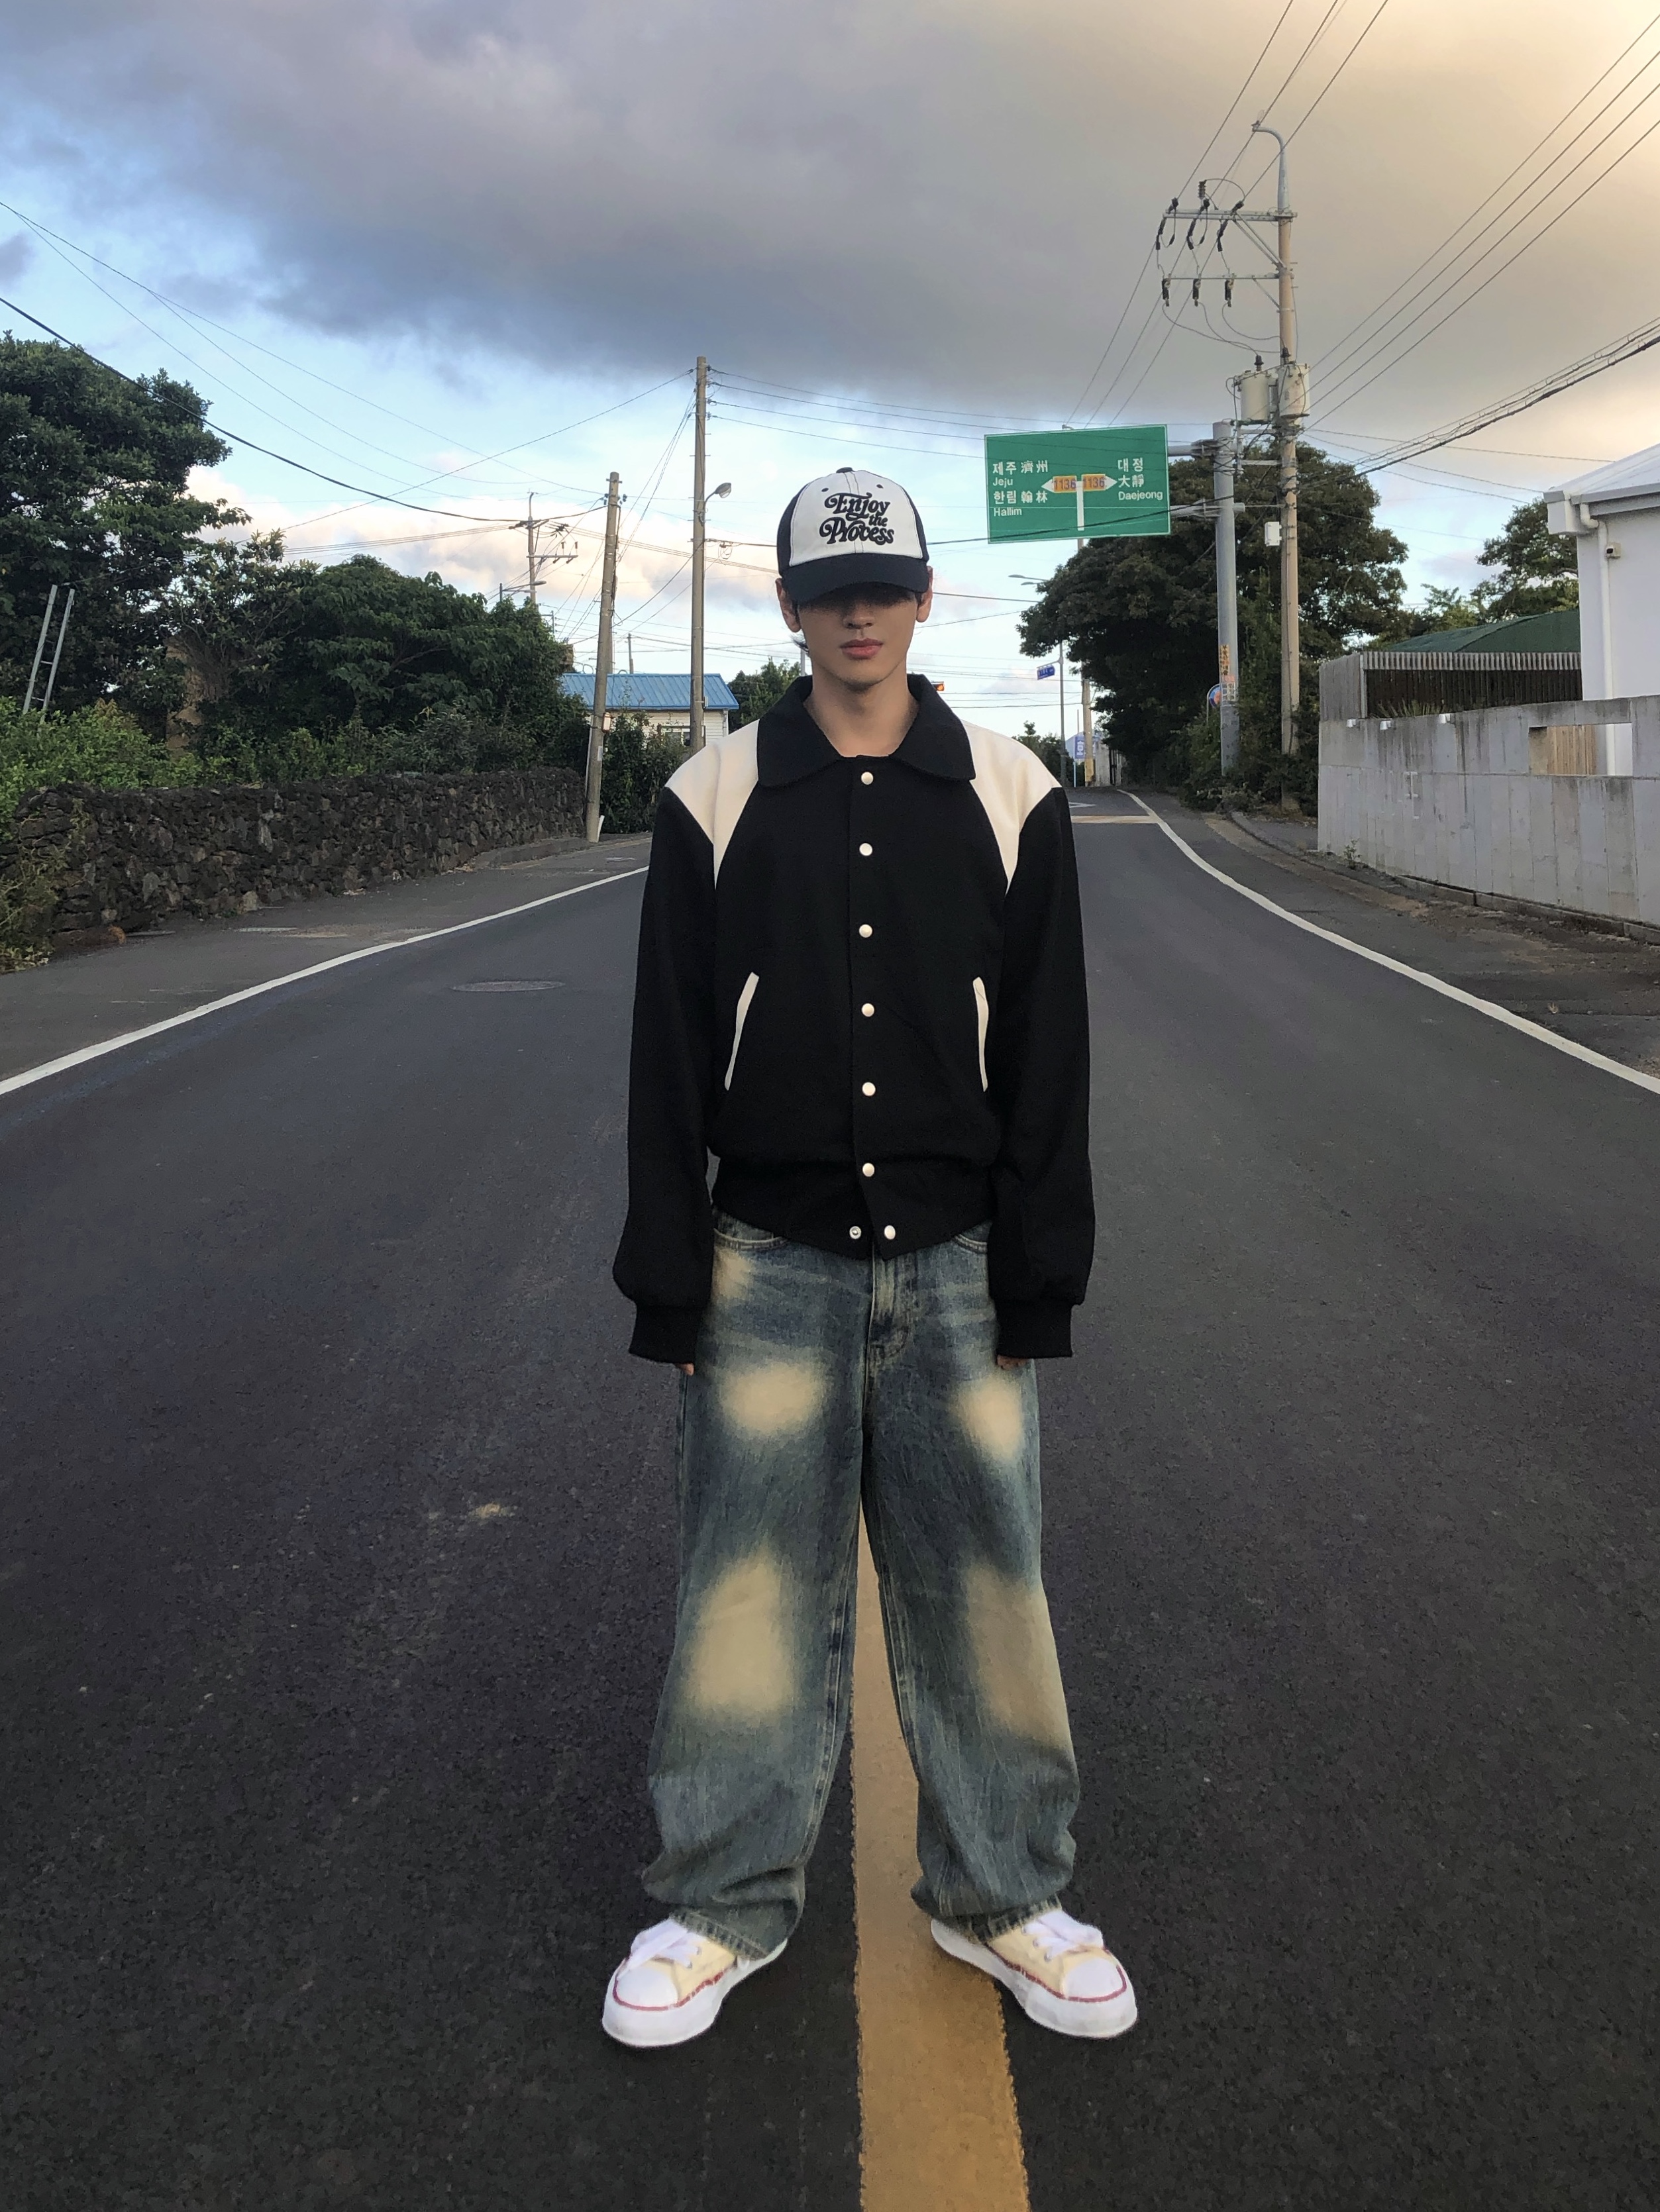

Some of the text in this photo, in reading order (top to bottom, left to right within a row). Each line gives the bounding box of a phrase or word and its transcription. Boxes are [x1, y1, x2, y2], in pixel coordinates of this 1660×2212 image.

[992, 461, 1017, 476] 제주
[1117, 457, 1143, 472] 대정
[992, 477, 1013, 488] Jeju
[1053, 478, 1076, 490] 1136
[1083, 477, 1106, 488] 1136
[994, 490, 1017, 504] 한림
[1118, 490, 1163, 501] Daejeong
[824, 492, 891, 521] Enjoy
[994, 507, 1022, 517] Hallim
[868, 514, 888, 527] the
[819, 517, 894, 545] Process
